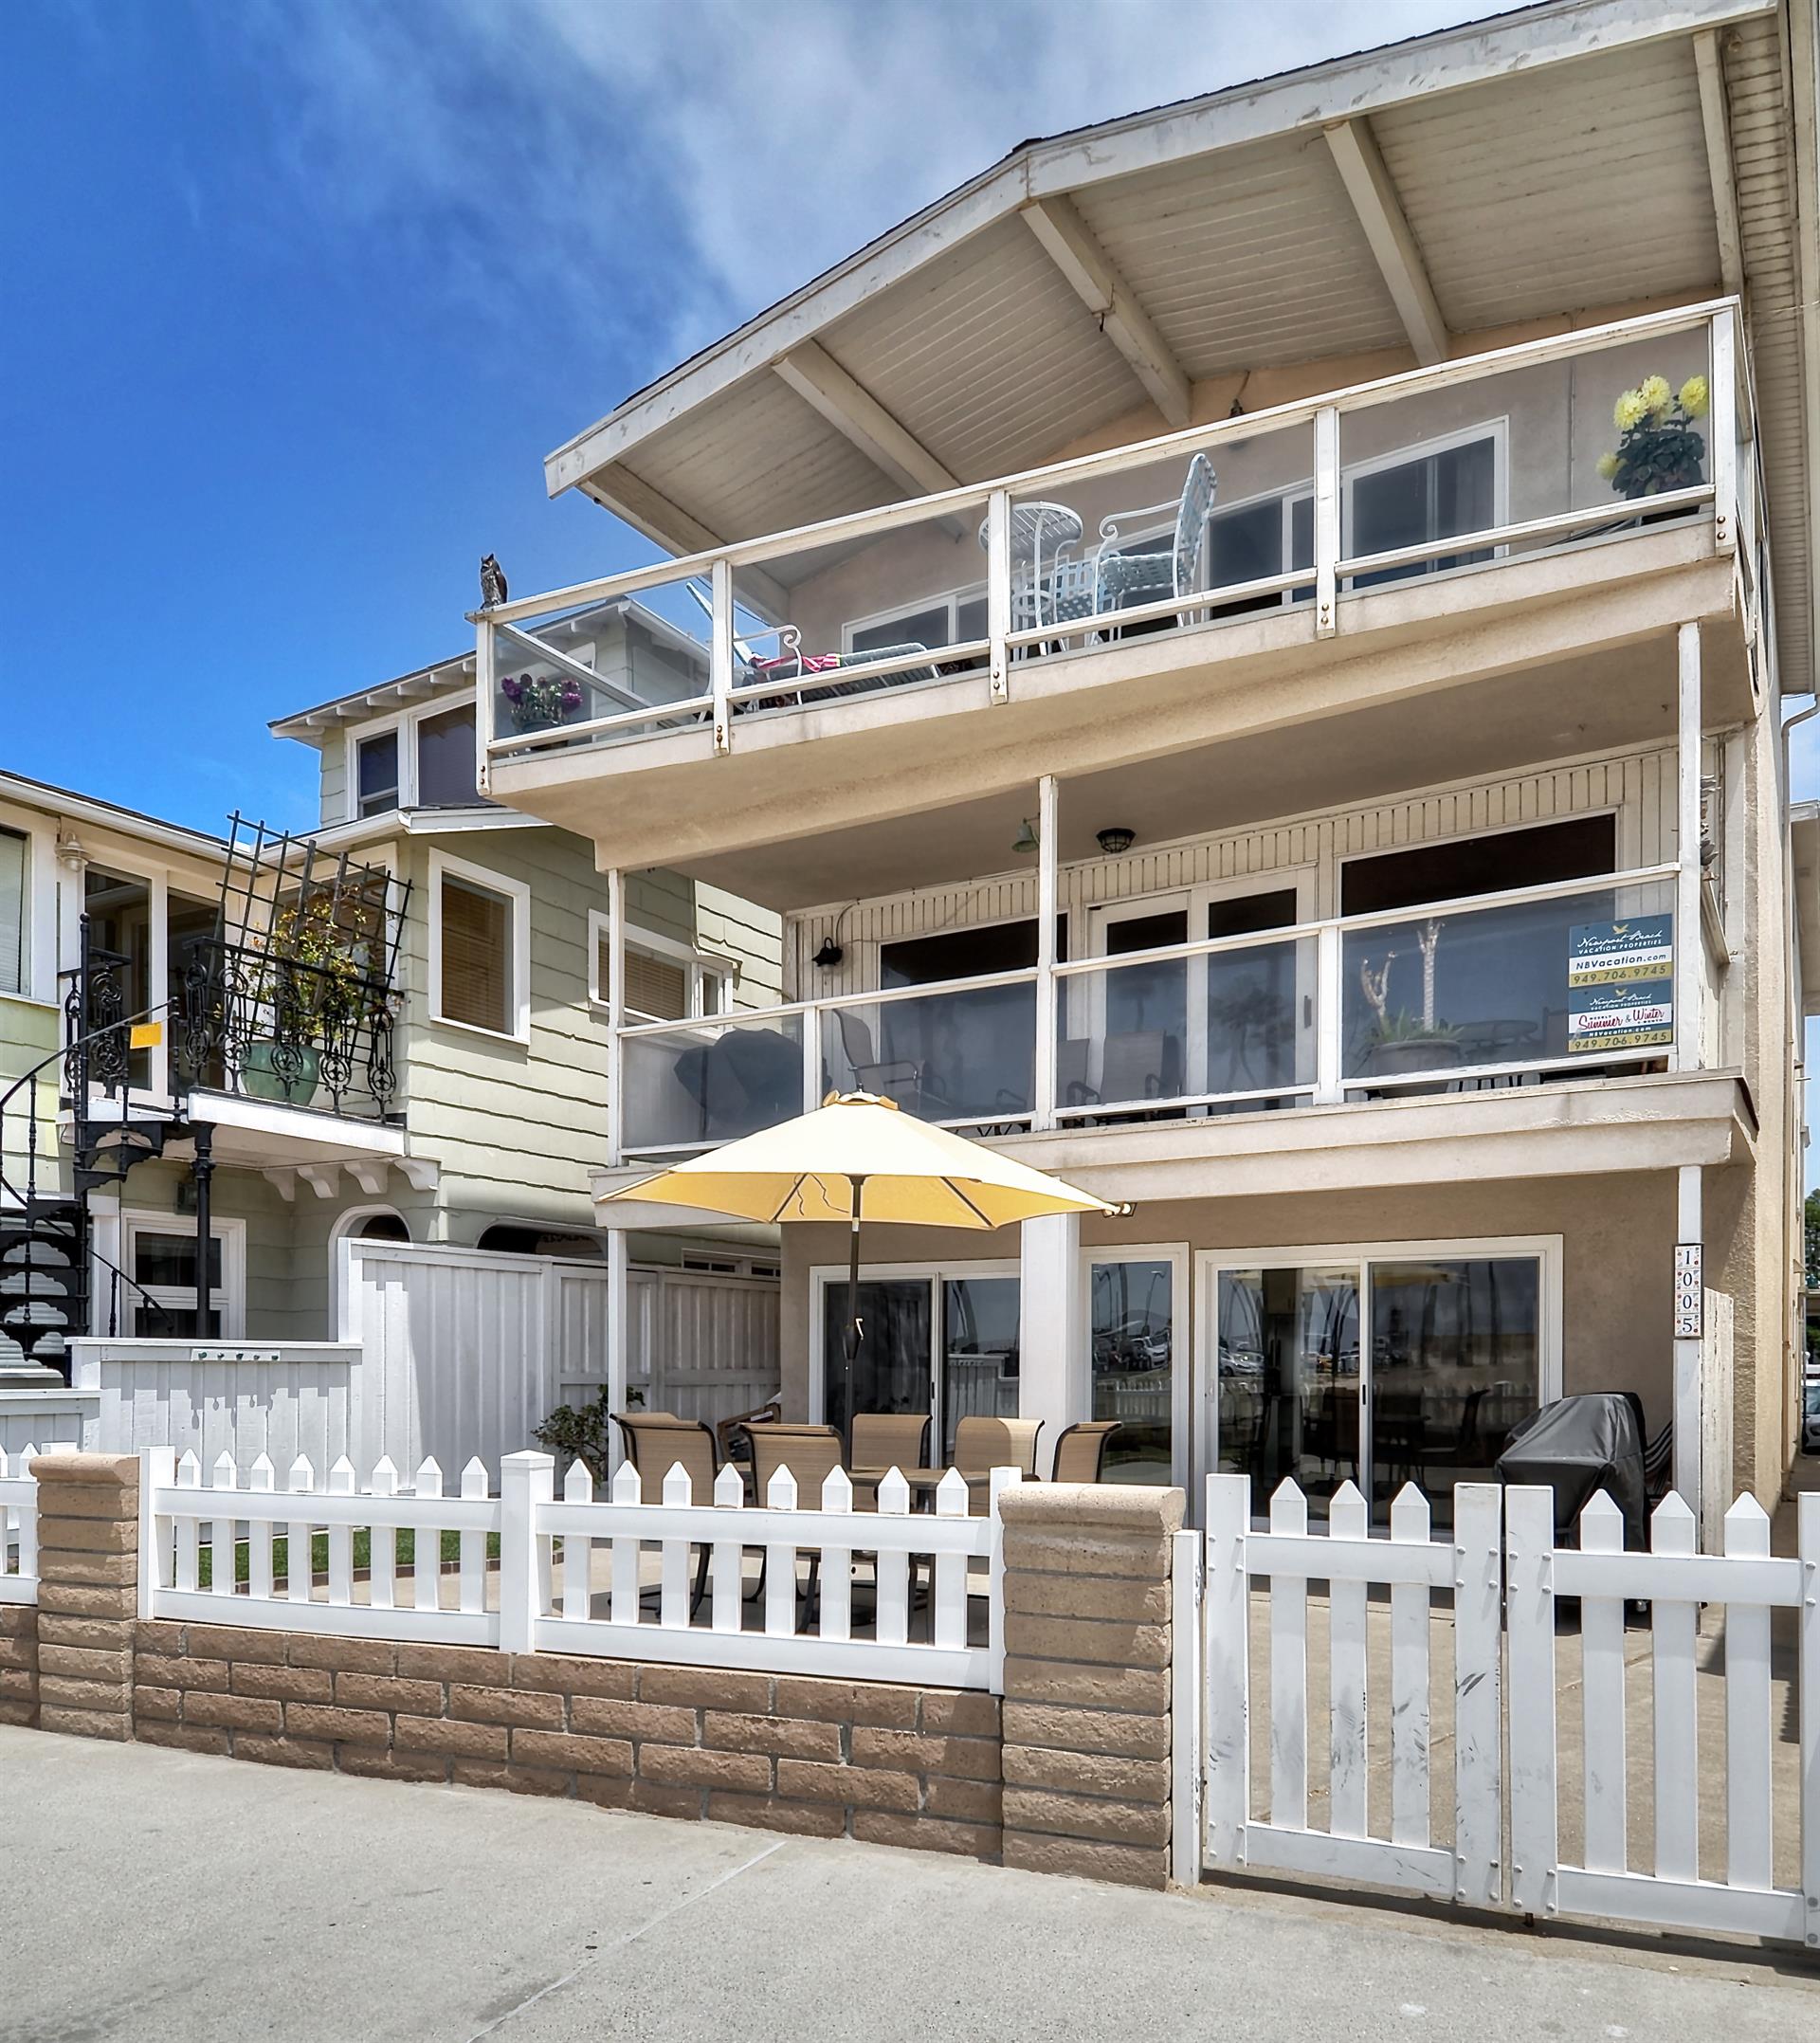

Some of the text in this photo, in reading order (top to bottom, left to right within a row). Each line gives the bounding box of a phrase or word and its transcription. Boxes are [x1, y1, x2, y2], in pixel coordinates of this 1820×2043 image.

[1577, 929, 1663, 948] Newport Beach
[1578, 939, 1662, 955] VACATION PROPERTIES
[1575, 954, 1666, 970] NBVacation.com
[1574, 965, 1666, 984] 949.706.9745
[1574, 1032, 1666, 1049] 949.706.9745
[1682, 1250, 1693, 1333] 1005
